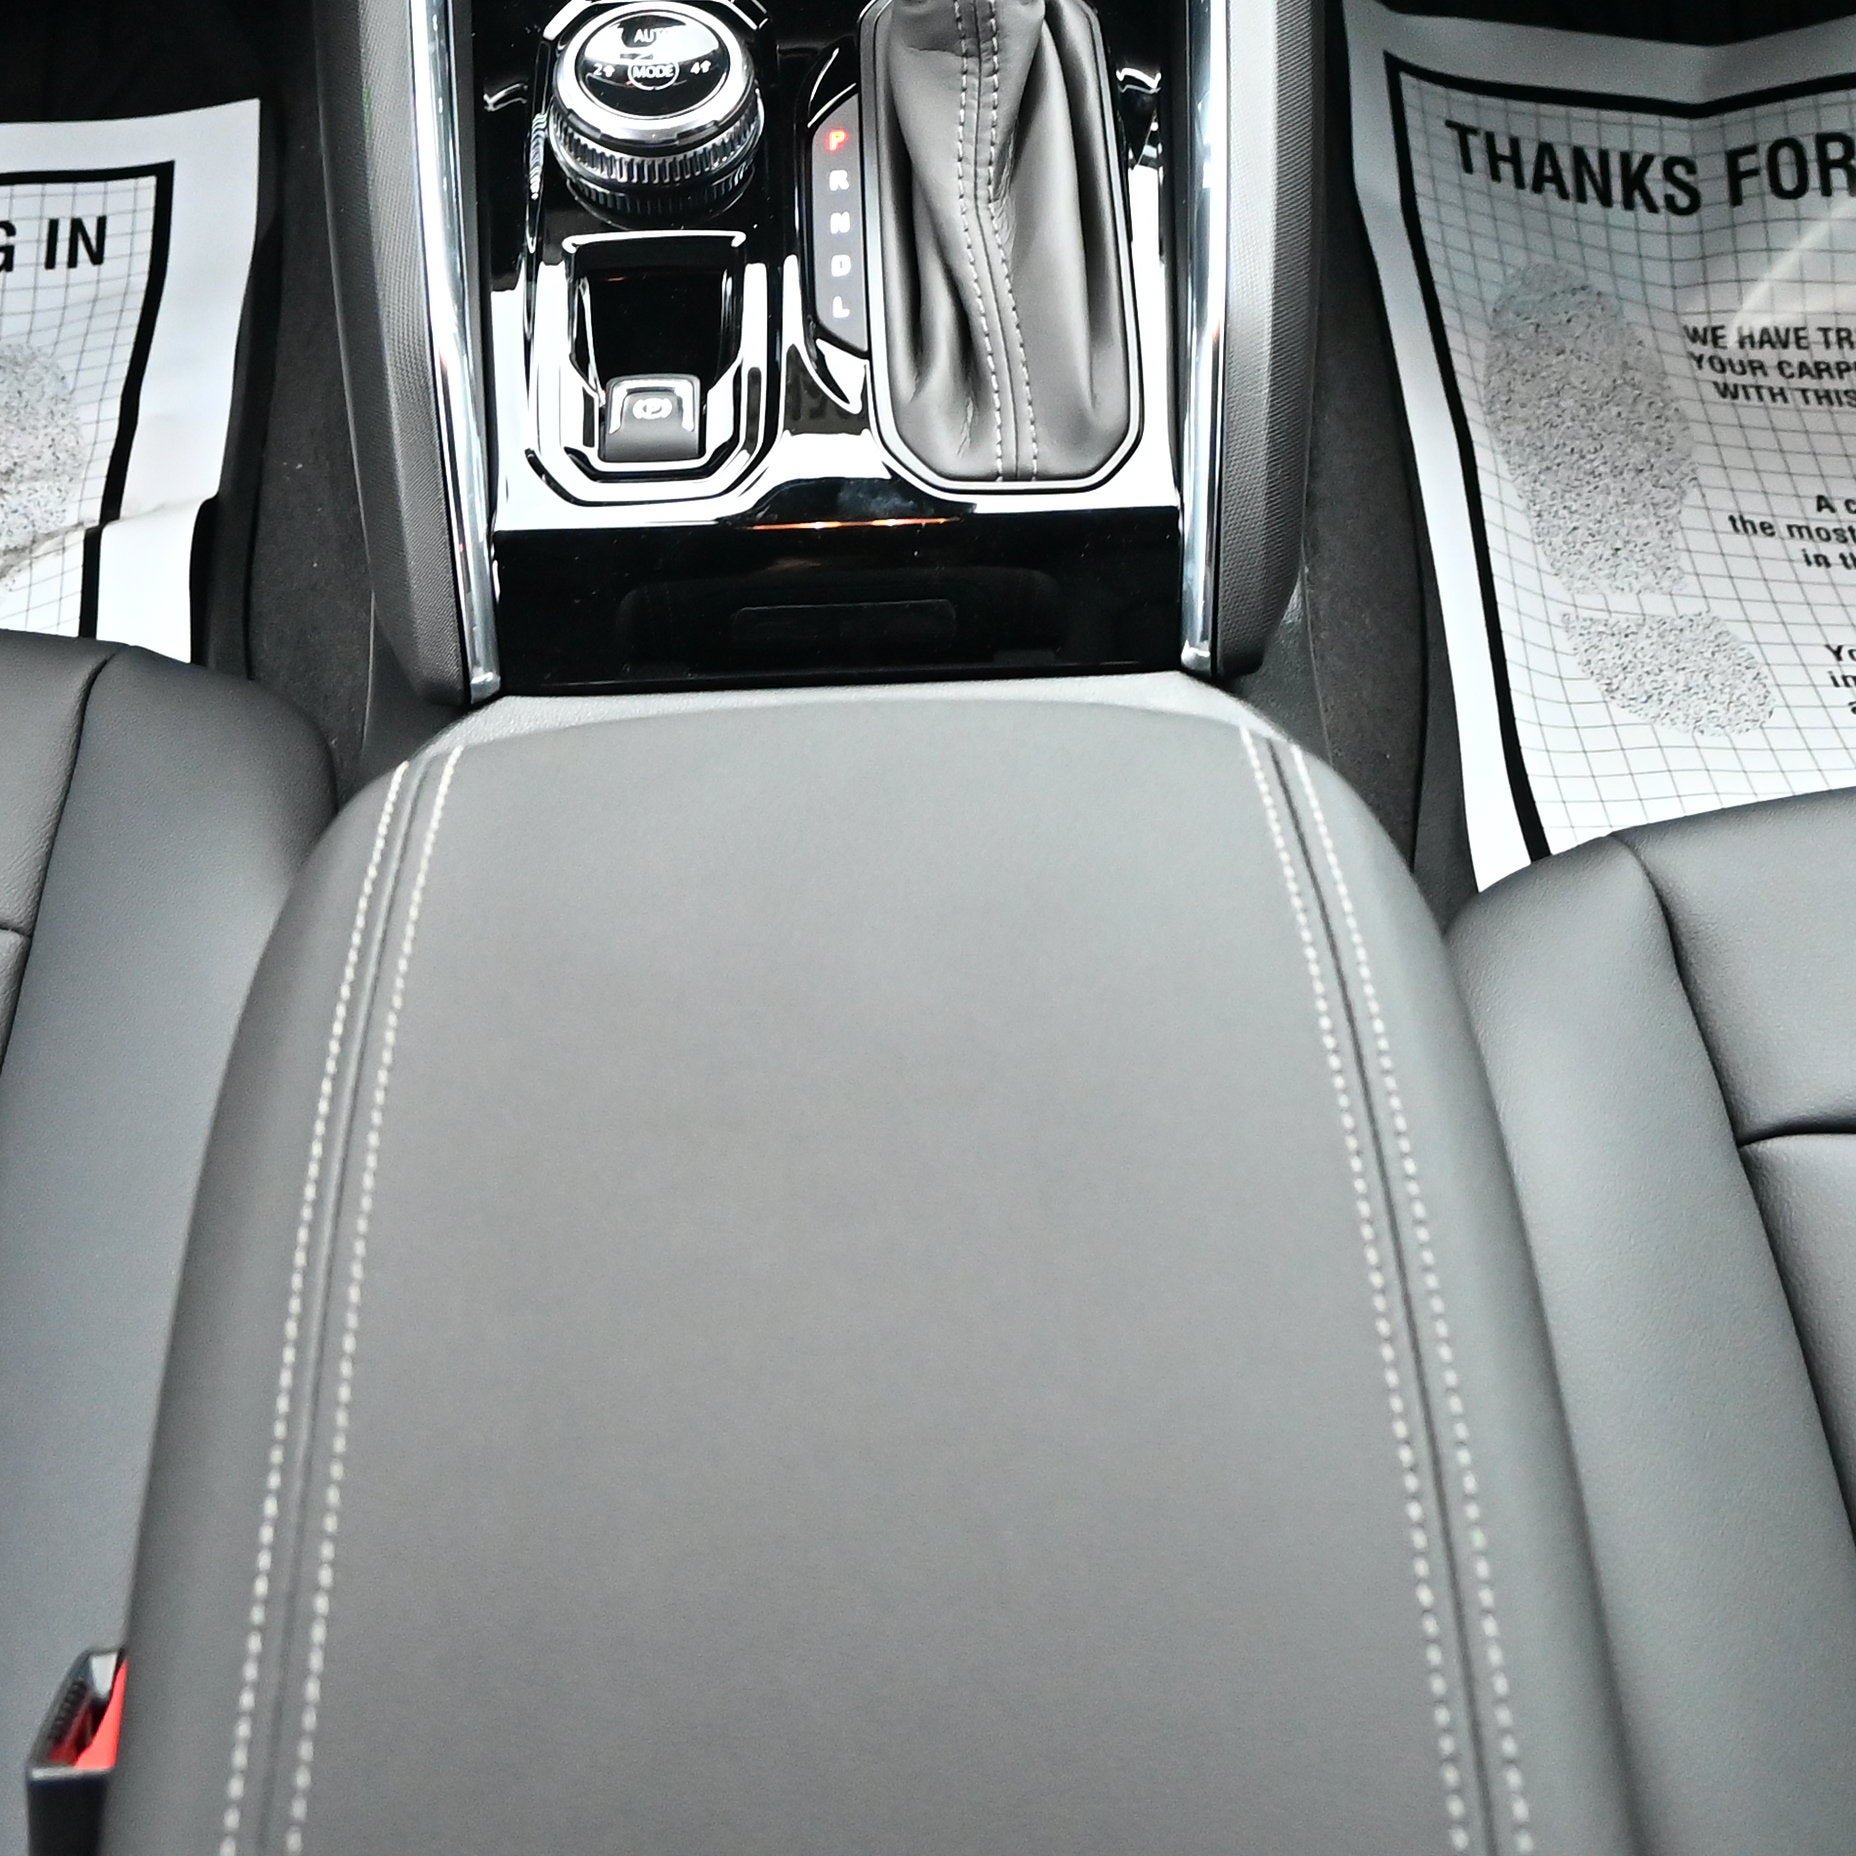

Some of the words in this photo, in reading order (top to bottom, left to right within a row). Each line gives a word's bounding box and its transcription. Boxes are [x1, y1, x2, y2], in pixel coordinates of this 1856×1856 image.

[632, 65, 675, 79] MODE
[828, 130, 846, 151] P
[829, 169, 850, 191] R
[1445, 120, 1701, 217] THANKS
[830, 211, 851, 234] N
[45, 215, 108, 269] IN
[830, 254, 852, 277] D
[832, 295, 850, 318] L
[1684, 325, 1726, 350] WE
[1738, 327, 1809, 350] HAVE
[1690, 353, 1770, 378] YOUR
[1713, 382, 1788, 404] WITH
[1815, 494, 1836, 514] A
[1728, 514, 1775, 537] the
[1802, 548, 1831, 569] in
